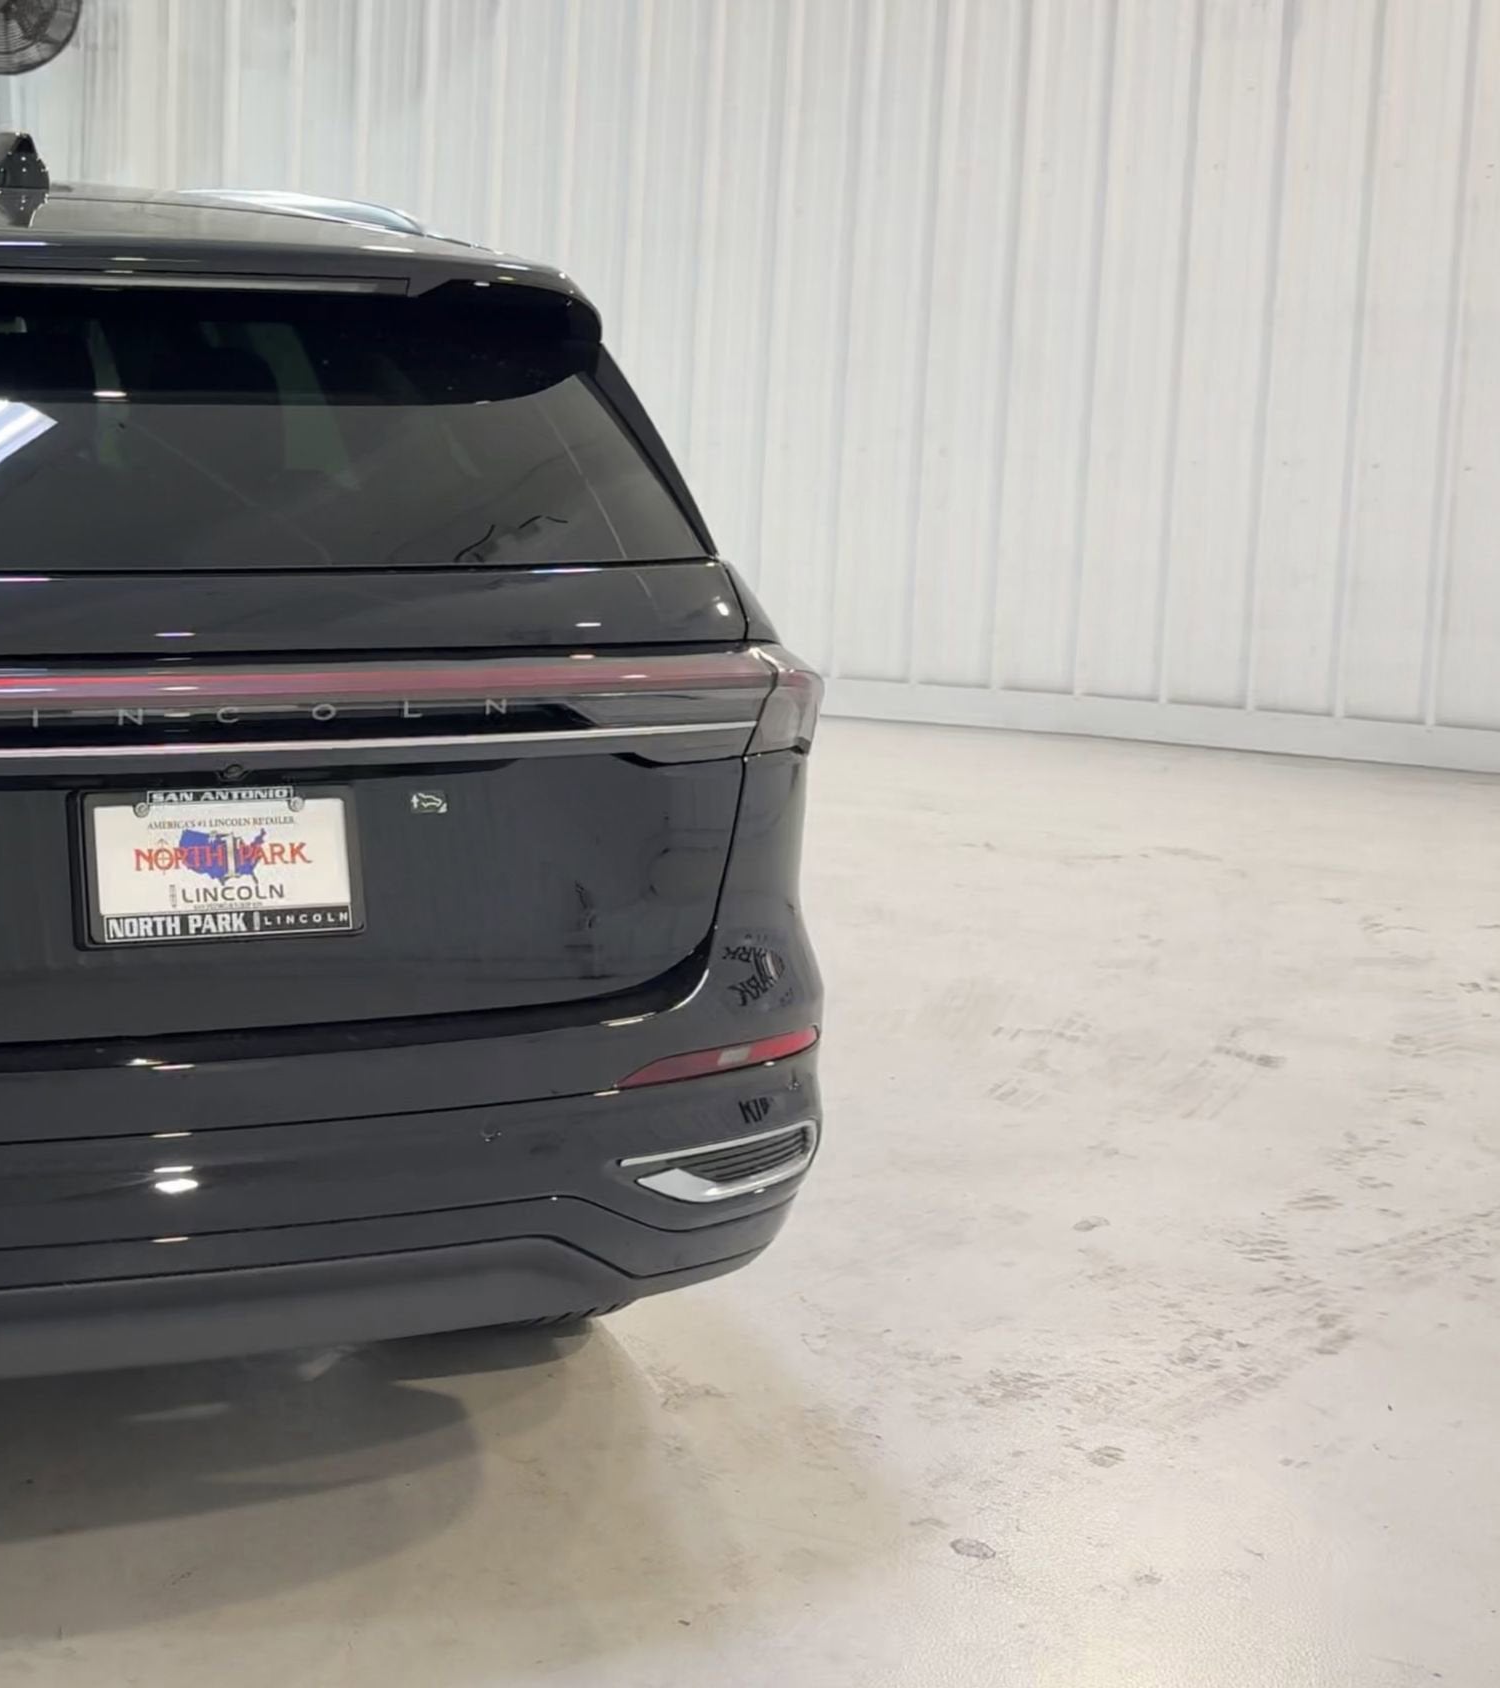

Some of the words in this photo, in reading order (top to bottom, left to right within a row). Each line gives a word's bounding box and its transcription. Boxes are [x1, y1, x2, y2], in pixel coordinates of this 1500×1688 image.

[152, 791, 193, 802] SAN
[200, 788, 288, 801] ANTONIO
[209, 817, 250, 828] LINCOLN
[134, 844, 224, 872] NORTH
[238, 841, 313, 866] PARK
[181, 883, 285, 904] LINCOLN
[108, 914, 182, 939] NORTH
[188, 911, 248, 935] PARK
[264, 911, 350, 926] LINCOLN
